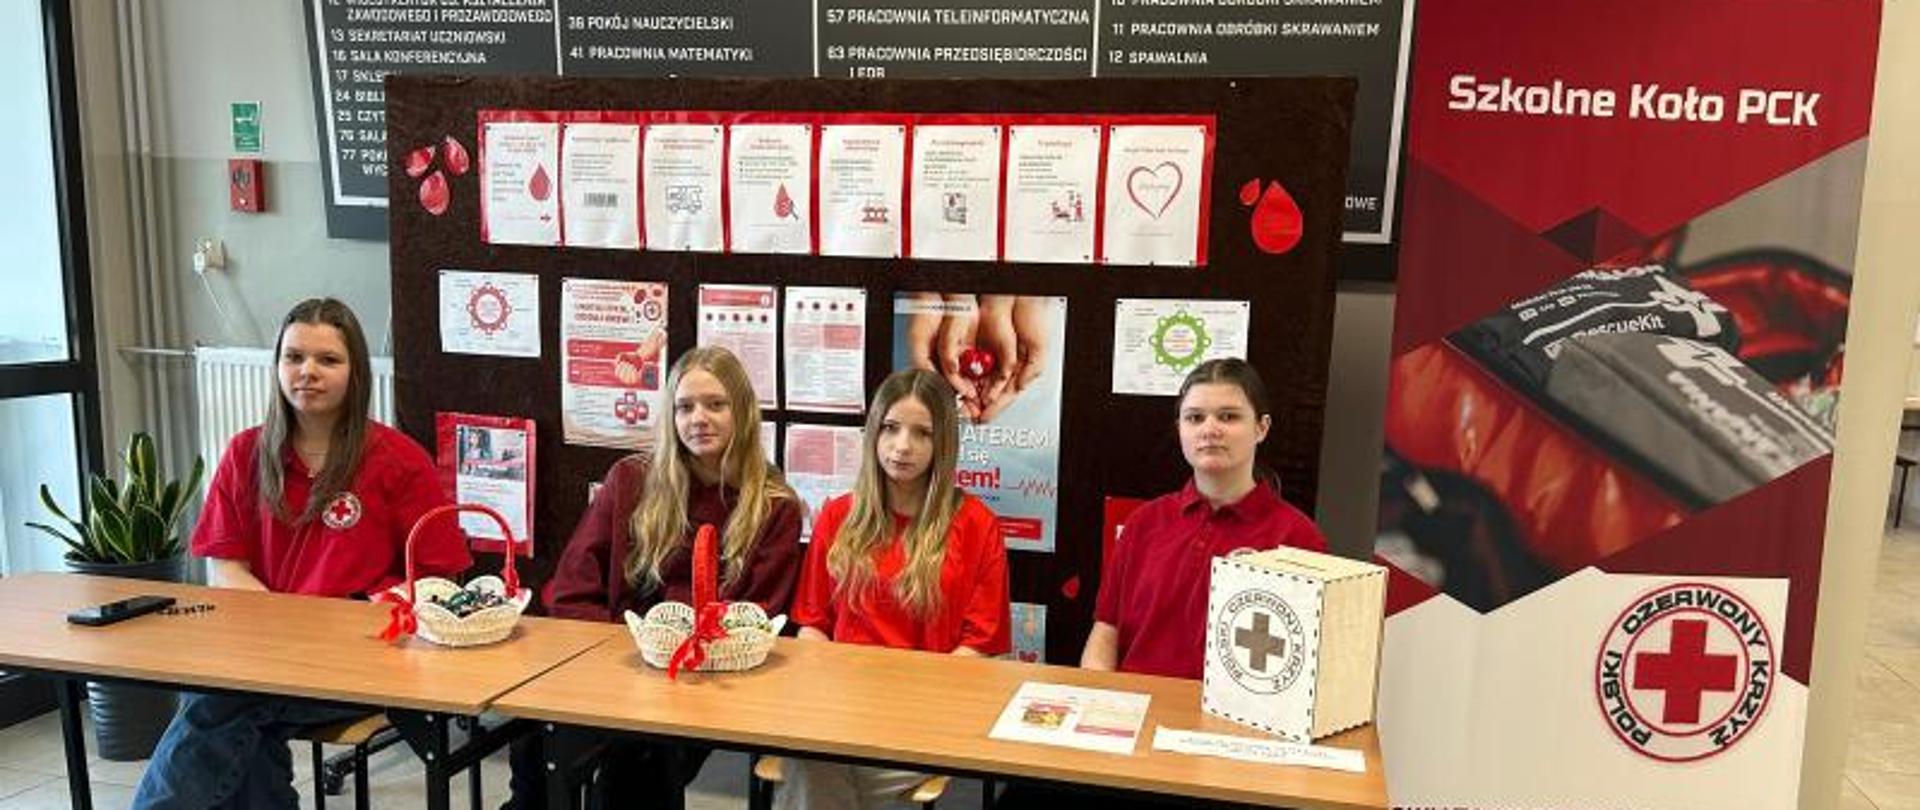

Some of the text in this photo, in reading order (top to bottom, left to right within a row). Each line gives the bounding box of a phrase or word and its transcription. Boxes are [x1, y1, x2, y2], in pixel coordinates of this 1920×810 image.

[588, 13, 628, 30] POKÓJ
[632, 16, 734, 30] NAUCZYCIELSKI
[827, 9, 1090, 24] 57 PRACOWNIA TELEINFORMATYCZNA
[1112, 19, 1380, 36] 11 PRACOWNIA OBRÓBKI SKRAWANIEM
[347, 29, 427, 42] SEKRETARIAT
[429, 30, 506, 44] UCZNIOWSKI
[351, 50, 381, 62] SALA
[384, 51, 487, 64] KONFERENCYJNA
[569, 46, 753, 61] 41 PRACOWNIA MATEMATYKI
[848, 46, 931, 61] PRACOWNIA
[934, 45, 1088, 63] PRZEDSIĘBIORCZOŚCI
[1109, 51, 1208, 64] 12 SPAWALNIA
[1448, 75, 1821, 126] Szkolne Koło PCK
[958, 424, 1050, 449] ATEREM
[1228, 592, 1303, 636] CZERWONY
[1602, 590, 1769, 748] POLSKI CZERWONY KRZYŻ
